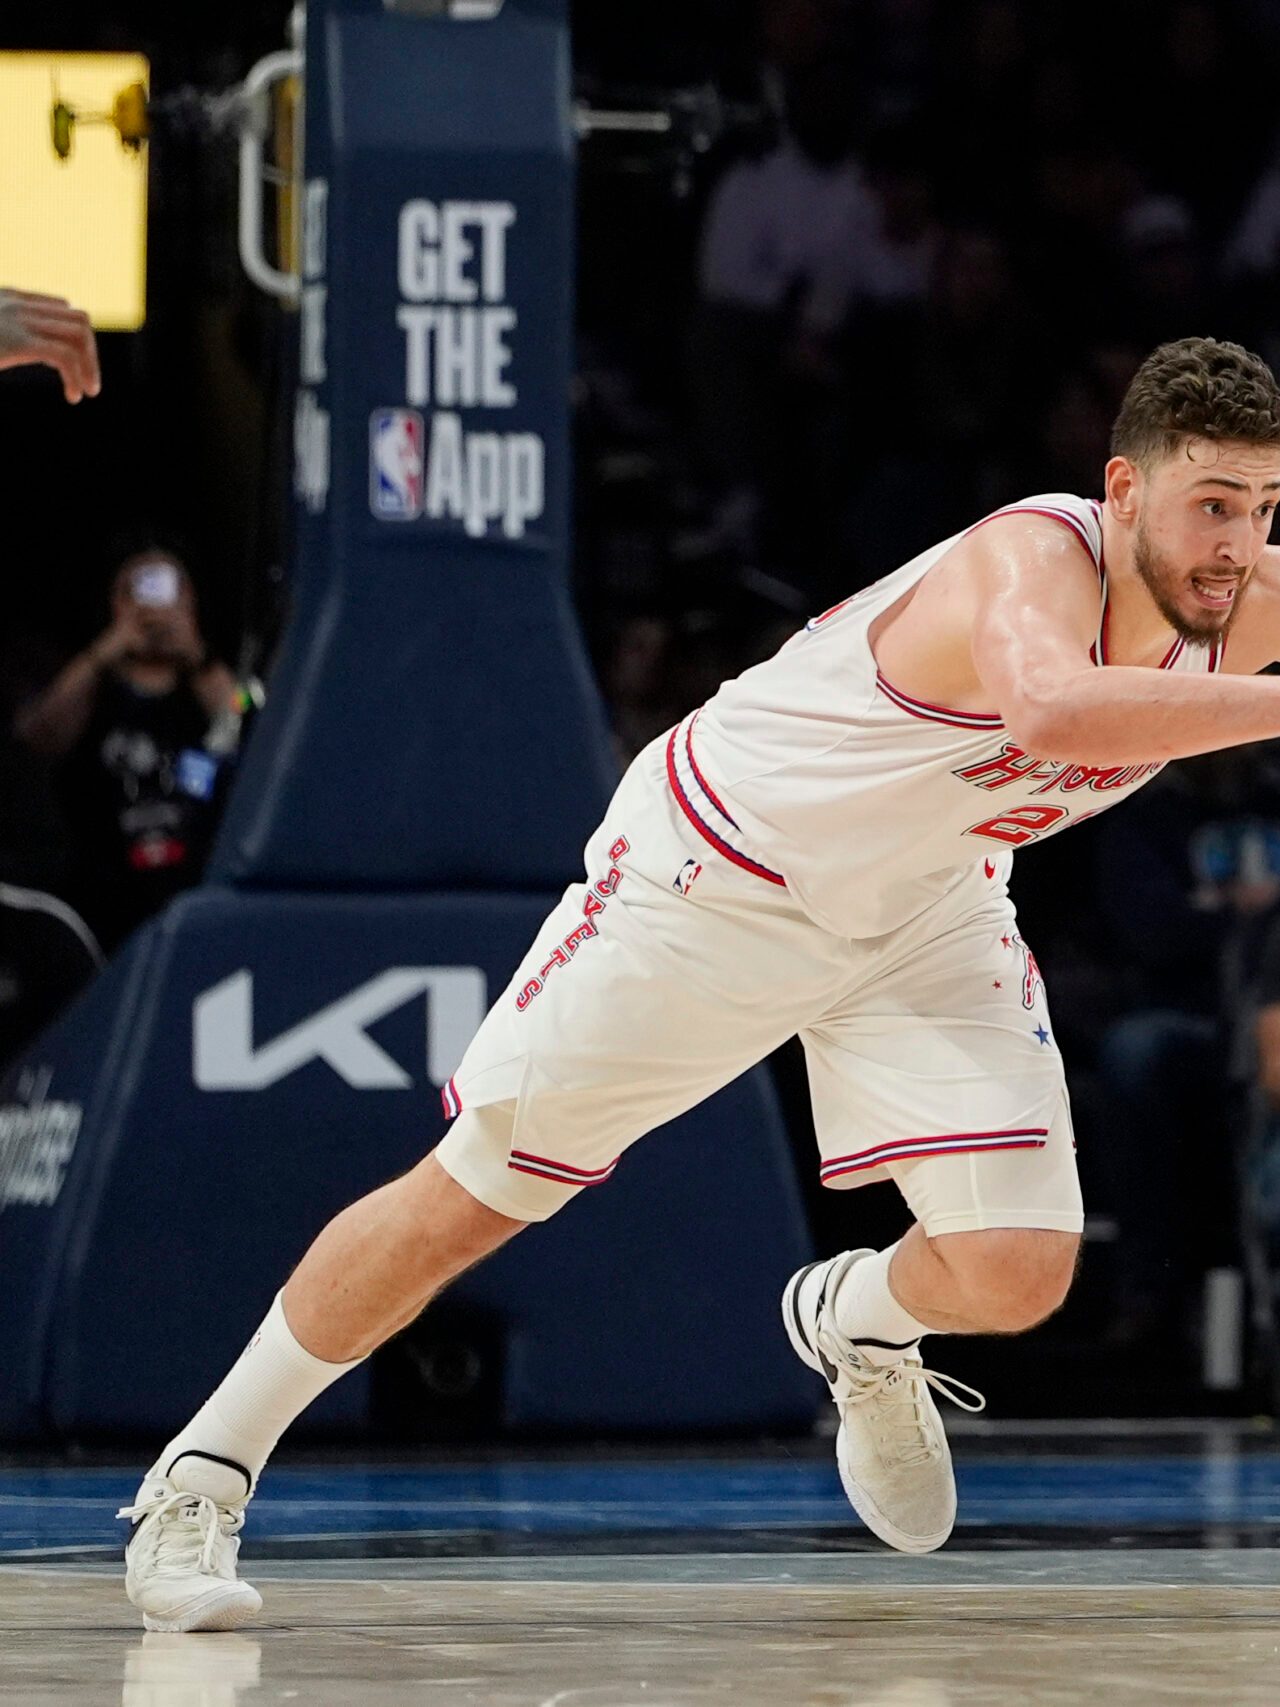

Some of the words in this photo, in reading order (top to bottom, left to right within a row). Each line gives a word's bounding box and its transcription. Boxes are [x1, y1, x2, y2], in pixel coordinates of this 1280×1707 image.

[398, 199, 517, 302] GET
[397, 305, 518, 407] THE
[426, 411, 545, 539] App
